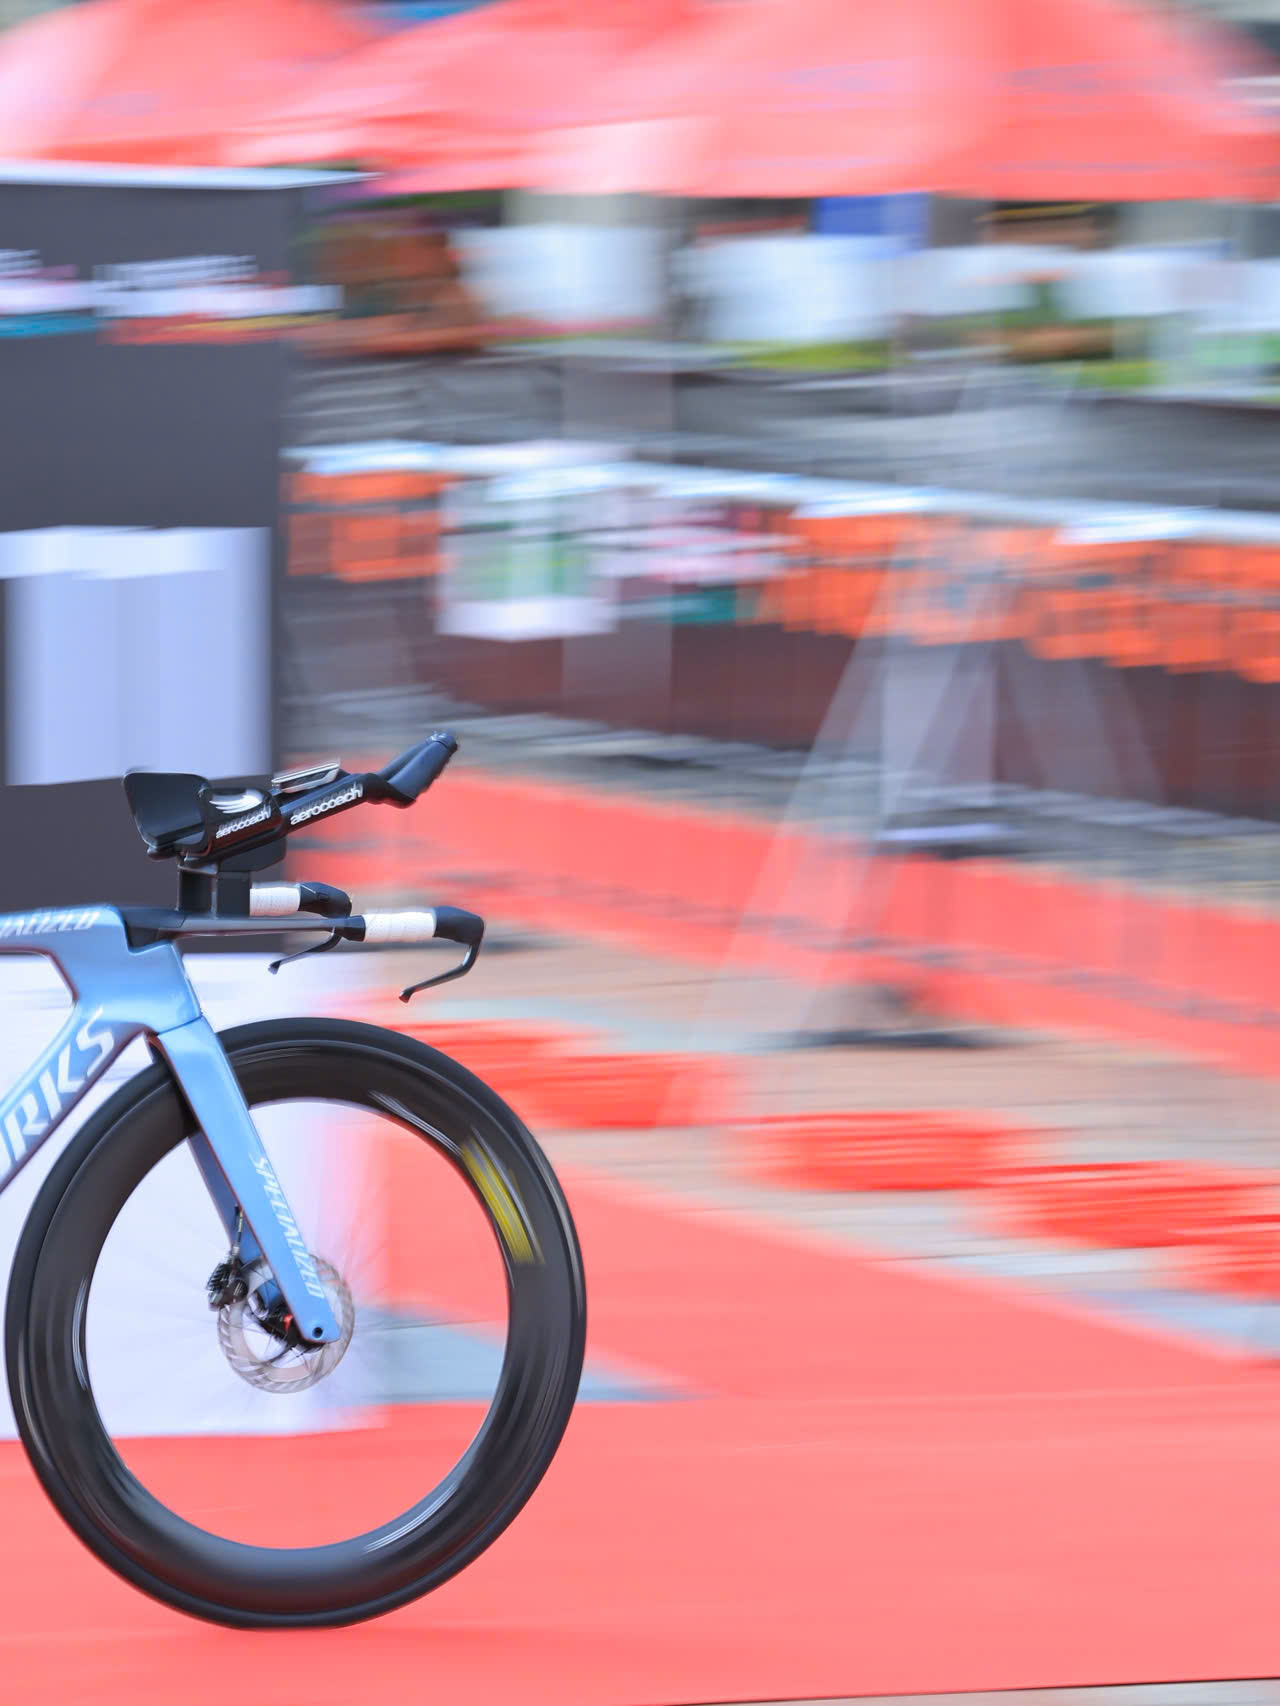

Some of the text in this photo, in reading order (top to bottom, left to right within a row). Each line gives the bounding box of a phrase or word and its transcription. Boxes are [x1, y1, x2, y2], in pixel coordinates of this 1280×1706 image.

[215, 800, 272, 840] aerocoach
[289, 780, 365, 826] aerocoach
[249, 1151, 326, 1300] SPECIALIZED
